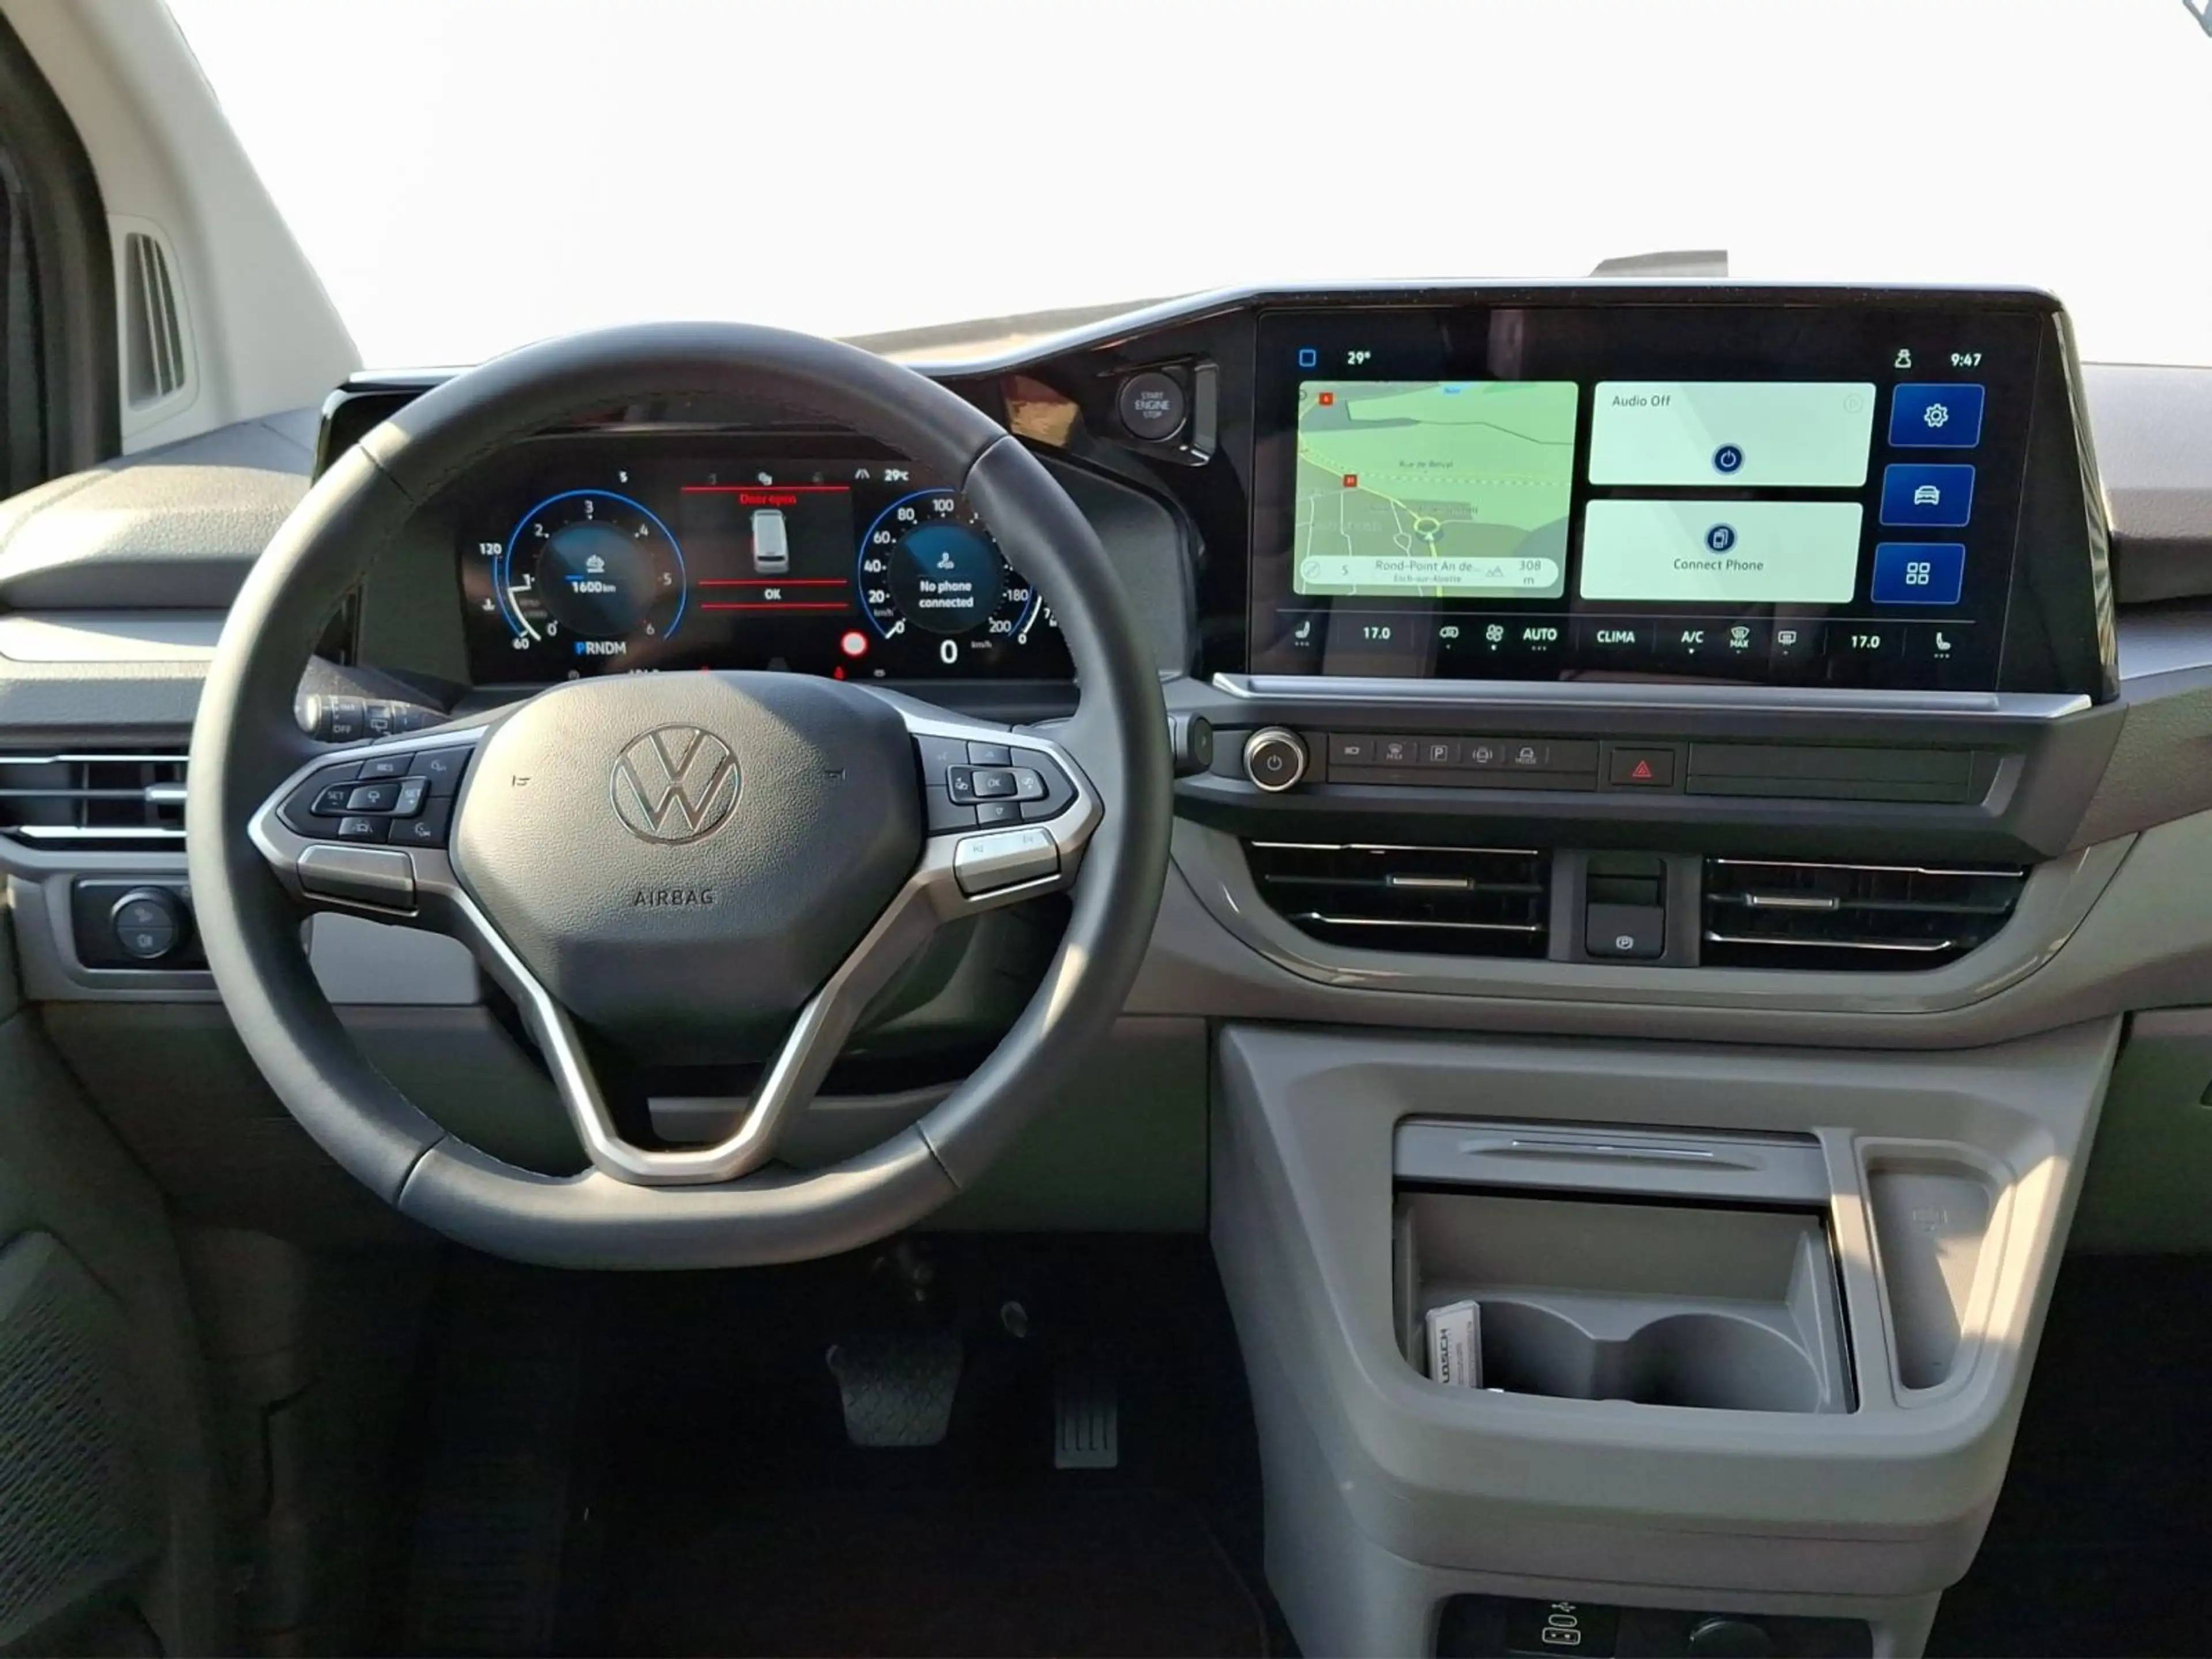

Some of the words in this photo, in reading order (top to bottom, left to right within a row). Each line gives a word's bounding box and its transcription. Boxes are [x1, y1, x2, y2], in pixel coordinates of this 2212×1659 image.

[1347, 351, 1371, 365] 29°
[1950, 353, 1982, 367] 9:47
[1612, 394, 1647, 407] Audio
[1650, 394, 1671, 407] Off
[585, 499, 594, 513] 3
[931, 499, 954, 512] 100
[897, 508, 915, 521] 80
[535, 524, 544, 537] 2
[639, 524, 649, 536] 4
[873, 531, 891, 544] 60
[479, 543, 502, 555] 120
[863, 559, 882, 573] 40
[1375, 559, 1438, 572] Rond-Point
[1441, 560, 1455, 572] An
[1518, 560, 1541, 571] 308
[1673, 558, 1722, 571] Connect
[1726, 559, 1764, 572] Phone
[521, 573, 531, 587] 1
[663, 573, 672, 586] 5
[1523, 577, 1534, 585] m
[572, 581, 603, 593] 1600
[919, 580, 937, 592] No
[937, 580, 972, 594] phone
[764, 588, 782, 600] OK
[868, 589, 885, 604] 20
[1006, 589, 1029, 601] 180
[918, 596, 975, 608] connected
[547, 622, 557, 637] 0
[646, 623, 655, 635] 6
[895, 620, 906, 634] 0
[988, 620, 1012, 633] 200
[1363, 626, 1391, 639] 17.0
[1017, 634, 1027, 645] 0
[1522, 627, 1558, 641] AUTO
[1596, 630, 1635, 643] CLIMA
[1681, 630, 1704, 644] A/C
[512, 637, 530, 650] 60
[971, 640, 993, 649] km/h
[1729, 638, 1749, 648] MAX
[1851, 635, 1880, 649] 17.0
[940, 639, 959, 664] 0
[987, 778, 1002, 787] OK
[326, 791, 344, 801] SET
[633, 889, 715, 907] AIRBAG
